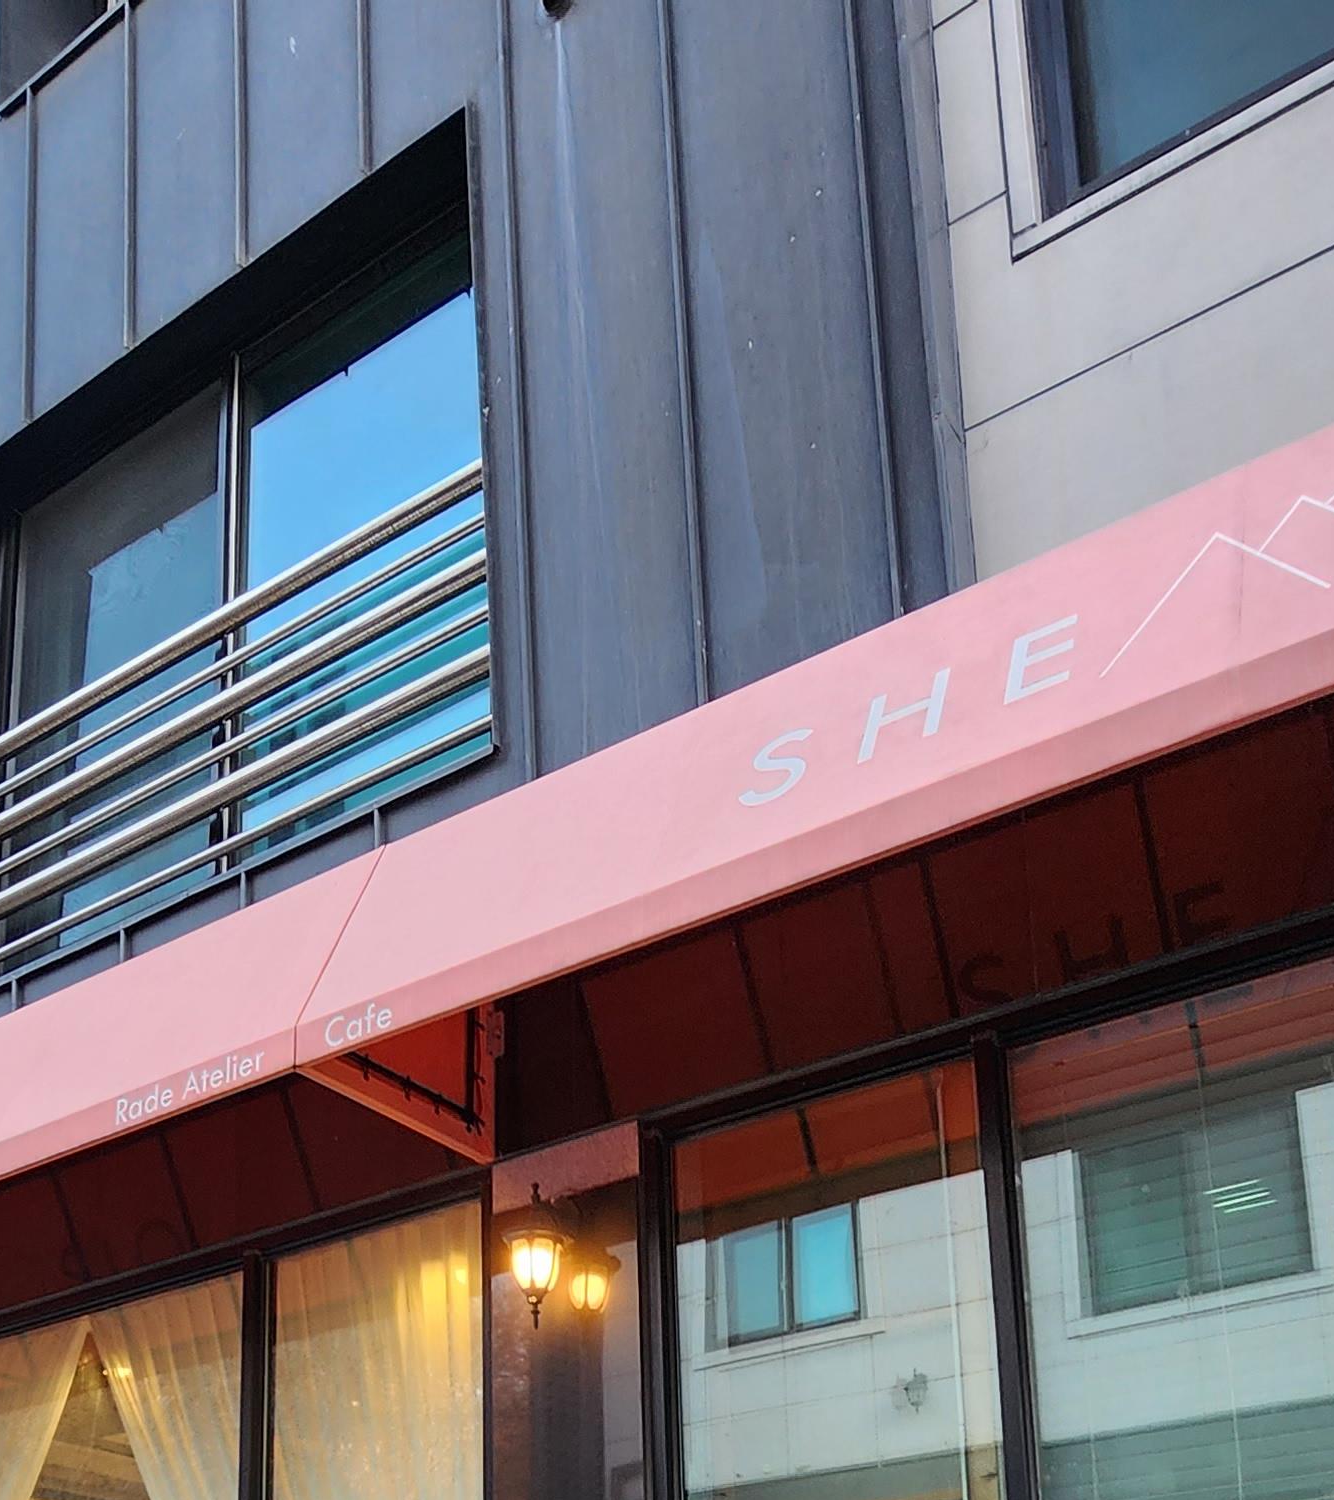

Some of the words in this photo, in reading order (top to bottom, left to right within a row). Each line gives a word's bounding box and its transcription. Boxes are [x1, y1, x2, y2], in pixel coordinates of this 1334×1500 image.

[323, 1003, 394, 1047] Cafe
[115, 1083, 174, 1126] Rade
[182, 1051, 265, 1101] Atelier
